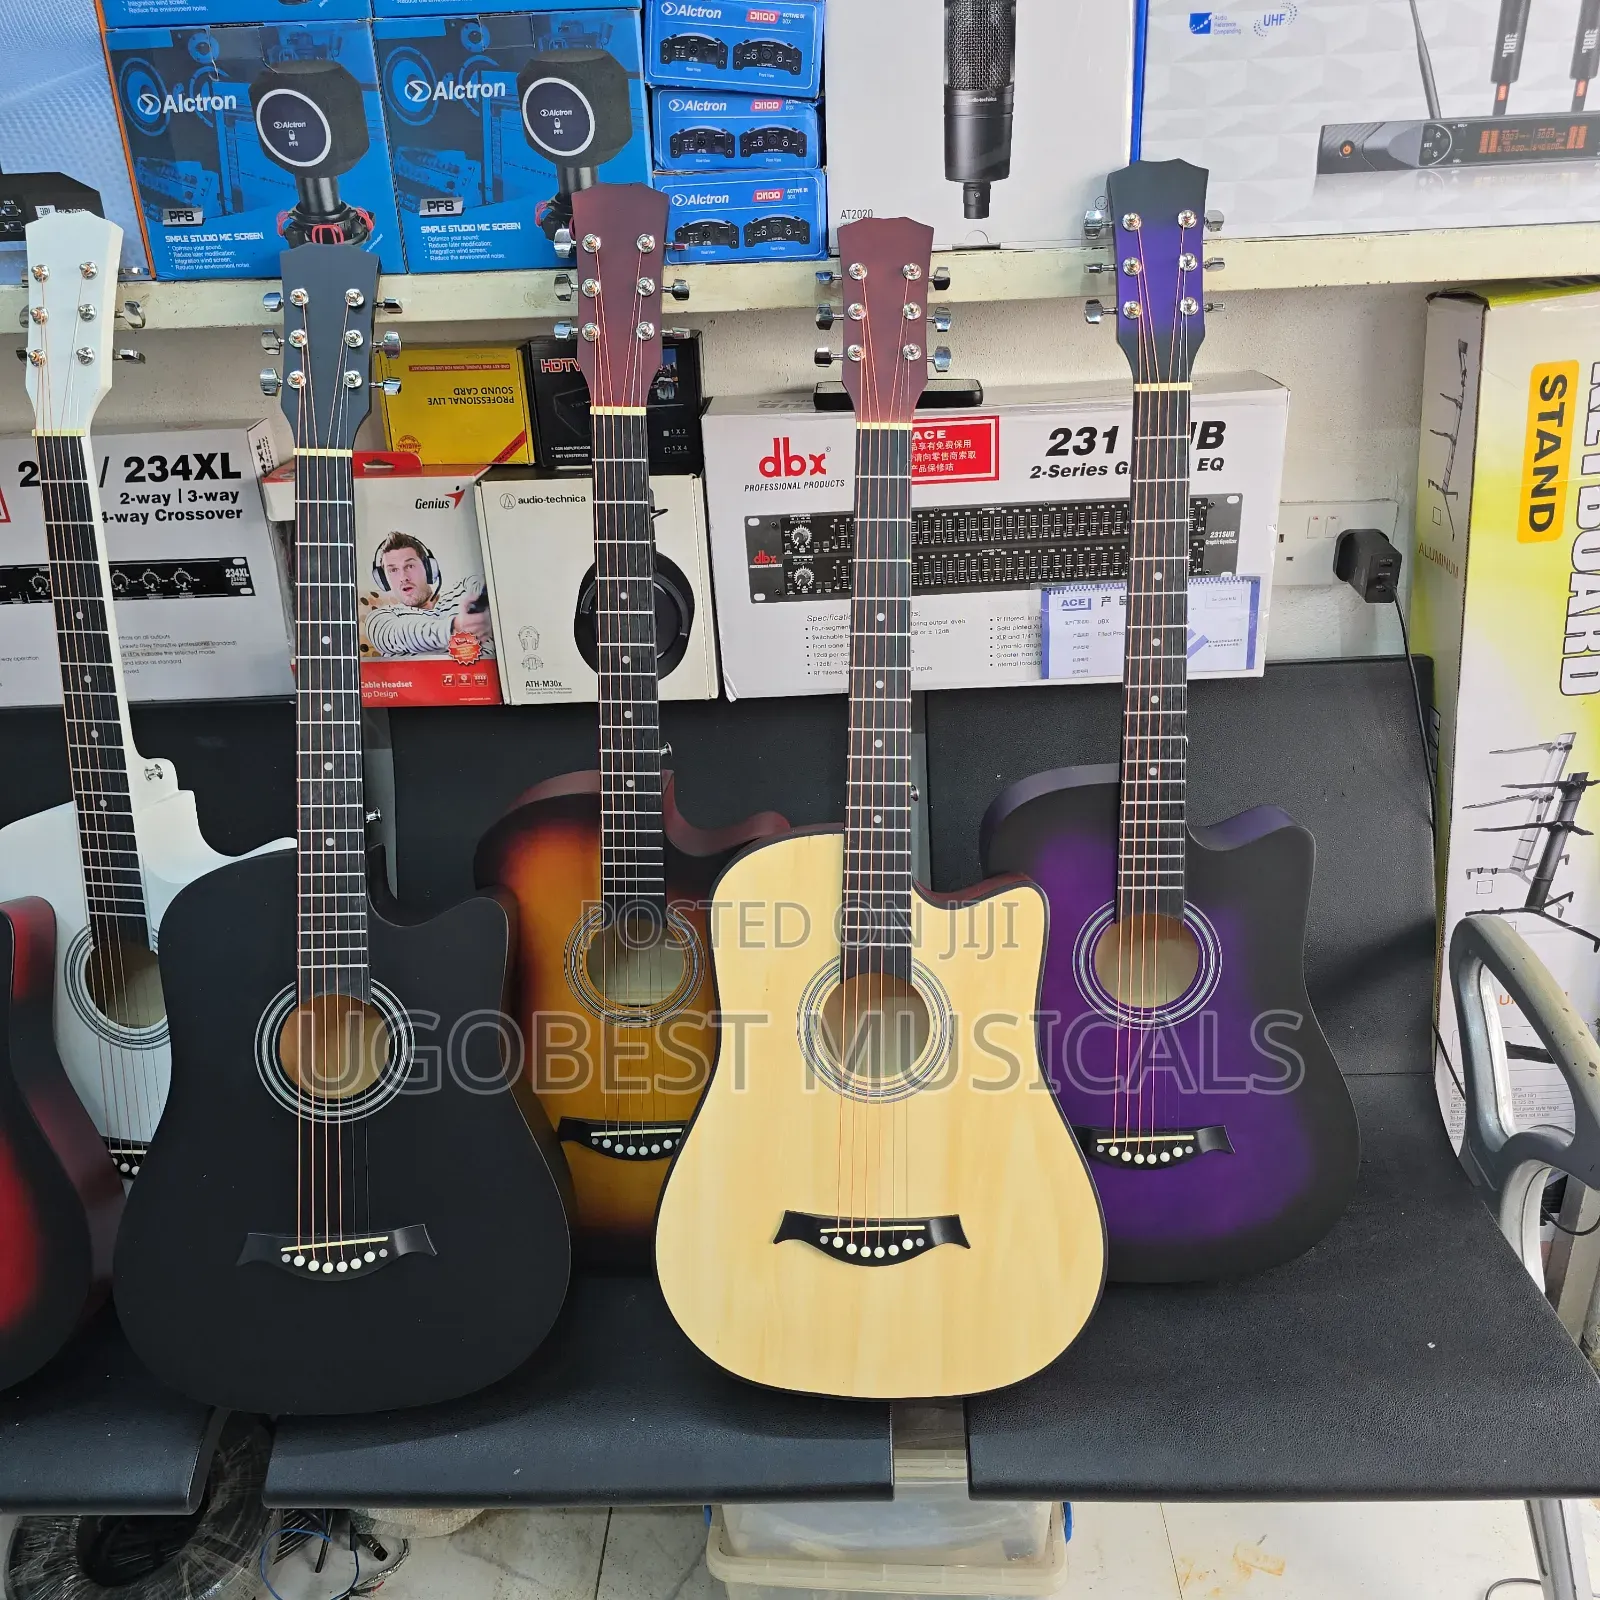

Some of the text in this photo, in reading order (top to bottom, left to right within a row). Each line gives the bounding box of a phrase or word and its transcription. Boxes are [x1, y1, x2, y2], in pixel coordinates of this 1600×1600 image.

[677, 4, 722, 19] Alctron
[749, 11, 776, 22] DI100
[1263, 13, 1286, 27] UHF
[433, 81, 506, 101] Alctron
[163, 94, 237, 114] Alctron
[684, 100, 727, 112] Alctron
[754, 101, 779, 110] DI100
[549, 109, 572, 117] Alctron
[283, 121, 306, 129] Alctron
[688, 194, 729, 205] Alctron
[427, 200, 455, 212] PF8
[168, 210, 195, 222] PF8
[841, 209, 874, 220] AT2020
[421, 222, 521, 234] SIMPLE STUDIO MIC SCREEN
[190, 234, 218, 243] STUDIO
[234, 232, 264, 241] SCREEN
[427, 235, 449, 243] Optimize
[450, 235, 462, 243] your
[429, 248, 456, 256] Integration
[454, 386, 514, 396] SOUND CARD
[427, 396, 515, 406] PROFESSIONAL LIVE
[912, 430, 947, 441] ACE
[759, 436, 827, 478] dbx
[1529, 373, 1568, 534] STAND
[124, 452, 242, 483] 234XL
[1197, 457, 1225, 472] EQ
[1030, 464, 1108, 479] 2-Series
[744, 479, 845, 492] PROFESSIONAL PRODUCTS
[120, 490, 240, 507] 2-way 3-way
[415, 498, 450, 510] Genius
[518, 494, 586, 505] audio-technica
[155, 508, 243, 522] Crossover
[753, 550, 777, 565] dbx
[1418, 542, 1459, 579] ALUMINUM
[225, 568, 250, 578] 234XL
[1061, 598, 1086, 607] ACE
[381, 680, 413, 689] Headset
[525, 680, 563, 688] ATH-M30x
[373, 690, 399, 698] Design
